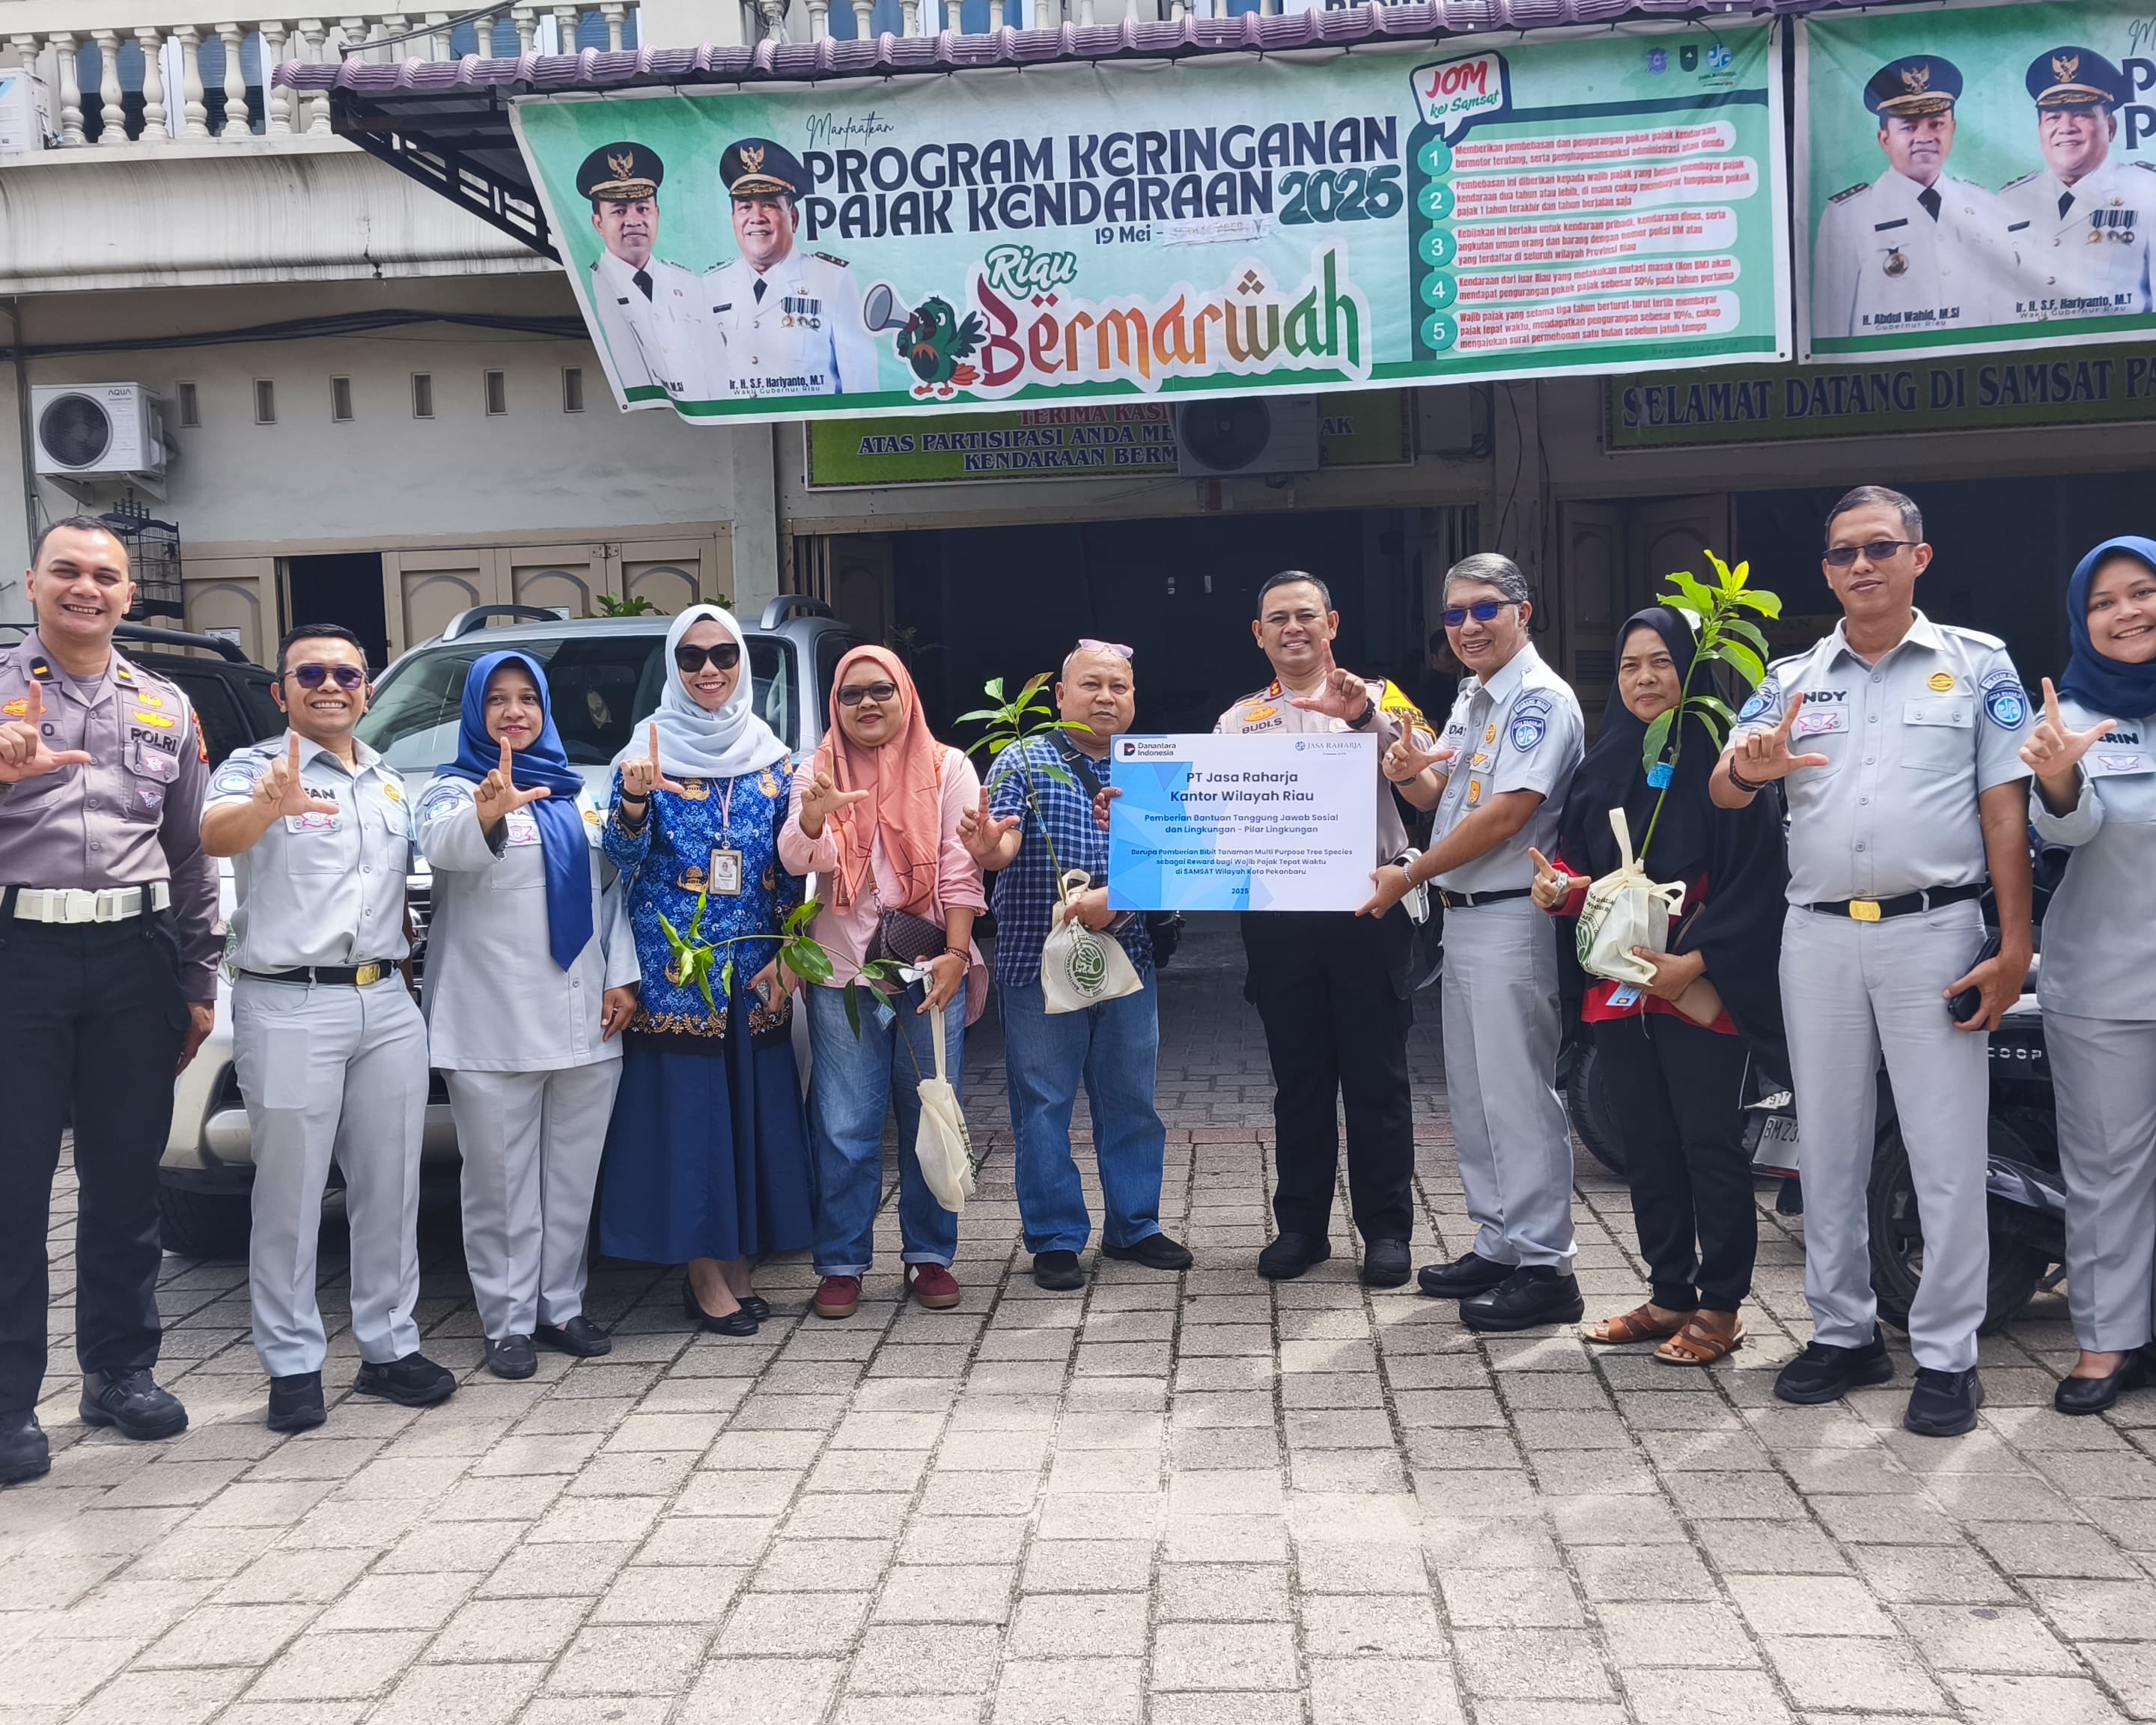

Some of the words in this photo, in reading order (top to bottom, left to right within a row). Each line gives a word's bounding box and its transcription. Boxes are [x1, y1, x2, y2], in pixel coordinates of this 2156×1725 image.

[1425, 61, 1487, 98] JOM
[1430, 103, 1448, 118] ke
[1450, 89, 1499, 112] Samsat
[806, 112, 894, 148] Manfaatkan
[803, 136, 1053, 195] PROGRAM
[1068, 116, 1398, 180] KERINGANAN
[1429, 150, 1437, 166] 1
[805, 190, 953, 241] PAJAK
[969, 170, 1274, 232] KENDARAAN
[1279, 165, 1403, 225] 2025
[1430, 192, 1442, 210] 2
[1095, 228, 1113, 245] 19
[1119, 225, 1151, 243] Mei
[1431, 238, 1443, 256] 3
[985, 244, 1077, 299] Riau
[1432, 281, 1446, 298] 4
[1863, 314, 1872, 326] H.
[1874, 311, 1901, 325] Abdul
[1904, 309, 1936, 323] Wahid,
[1939, 306, 1960, 319] M.Si
[2051, 307, 2100, 317] Gubernur
[1434, 323, 1446, 340] 5
[1875, 322, 1921, 331] Gubernur
[729, 380, 738, 389] Ir.
[740, 379, 749, 389] H.
[750, 379, 764, 389] S.F.
[766, 376, 808, 388] Hariyanto,
[810, 374, 824, 385] M.T
[1623, 380, 1773, 428] SELAMAT
[1784, 371, 1916, 419] DATANG
[1929, 368, 1967, 410] DI
[1979, 359, 2113, 407] SAMSAT
[1018, 407, 1108, 425] TERIMA
[858, 434, 915, 455] ATAS
[922, 428, 1065, 452] PARTISIPASI
[1070, 425, 1136, 445] ANDA
[964, 448, 1106, 471] KENDARAAN
[130, 727, 177, 752] POLRI
[1187, 773, 1203, 782] PT
[1206, 773, 1239, 782] Jasa
[1243, 770, 1298, 785] Raharja
[1171, 791, 1218, 802] Kantor
[1222, 790, 1279, 805] Wilayah
[1283, 789, 1314, 801] Riau
[1145, 814, 1192, 822] Pemberian
[1234, 814, 1278, 823] Tanggung
[1312, 813, 1339, 821] Sosial
[1184, 825, 1235, 835] Lingkungan
[1266, 825, 1318, 835] Lingkungan
[1324, 848, 1353, 857] Species
[1216, 858, 1232, 866] bagi
[1234, 858, 1255, 866] Wajib
[1257, 858, 1277, 866] Pajak
[1215, 868, 1246, 876] Wilayah
[1764, 1120, 1781, 1140] BM
[1782, 1122, 1799, 1143] 23
